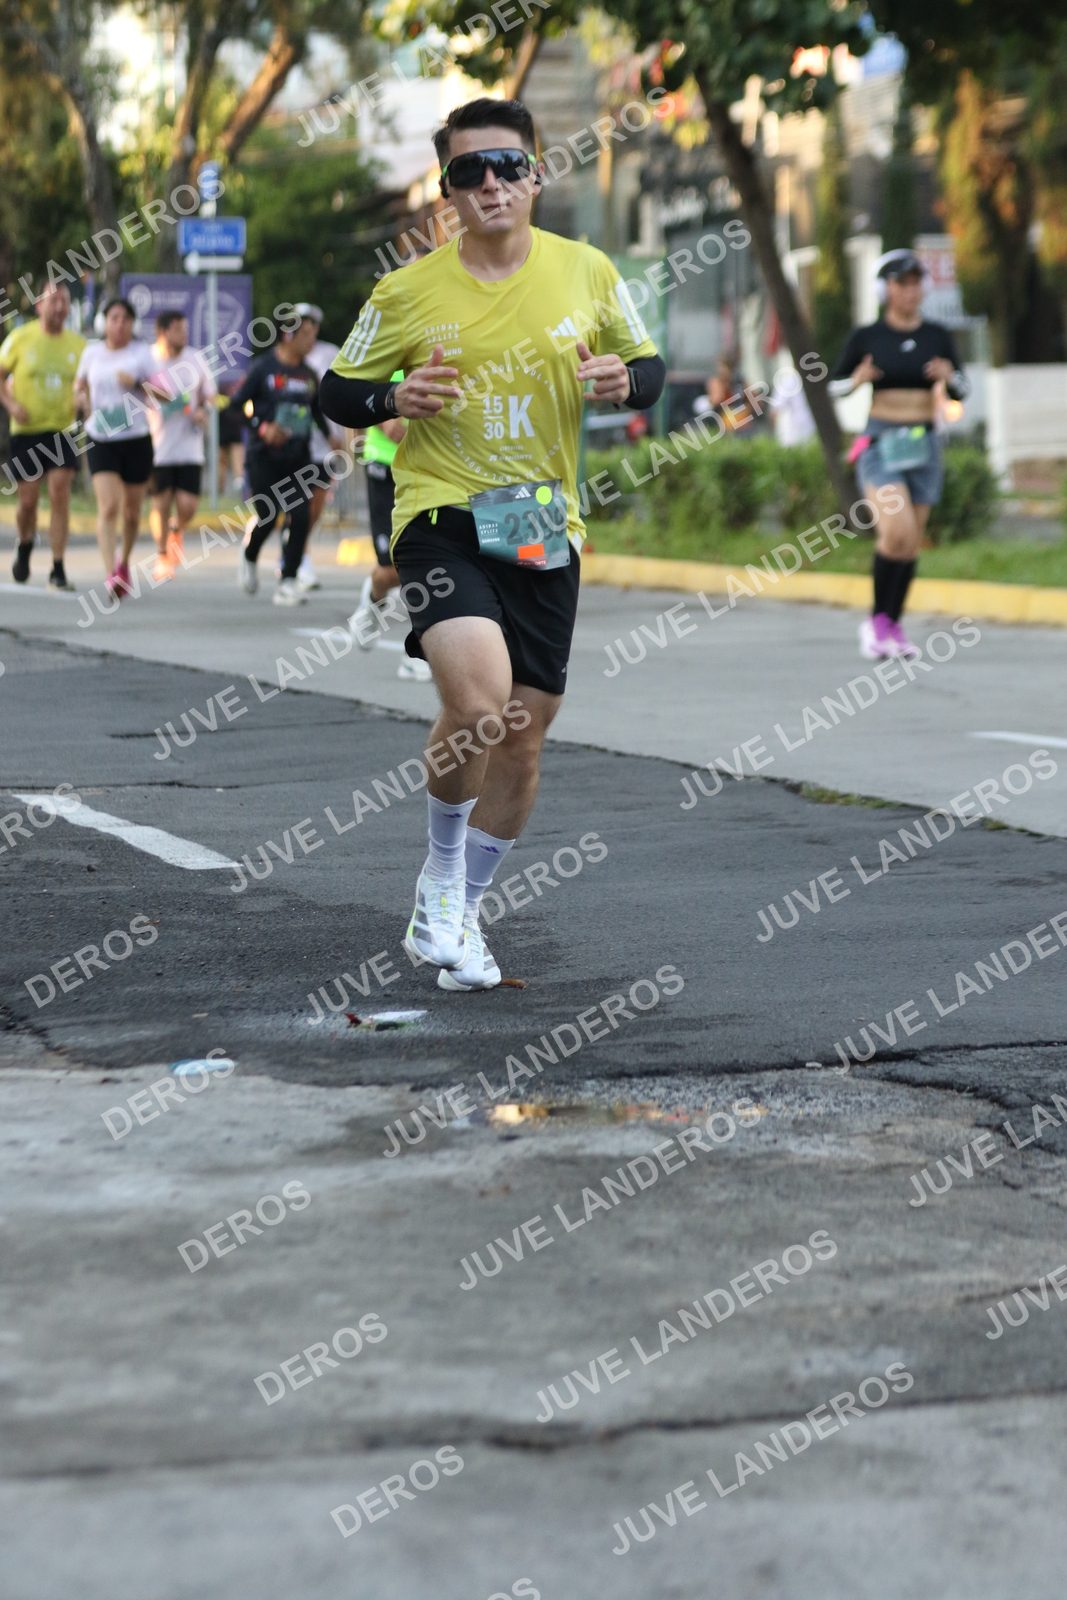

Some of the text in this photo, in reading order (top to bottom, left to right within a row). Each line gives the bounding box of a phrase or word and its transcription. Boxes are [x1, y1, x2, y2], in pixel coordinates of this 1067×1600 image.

[483, 395, 504, 414] 15
[508, 394, 536, 439] K
[483, 421, 505, 440] 30
